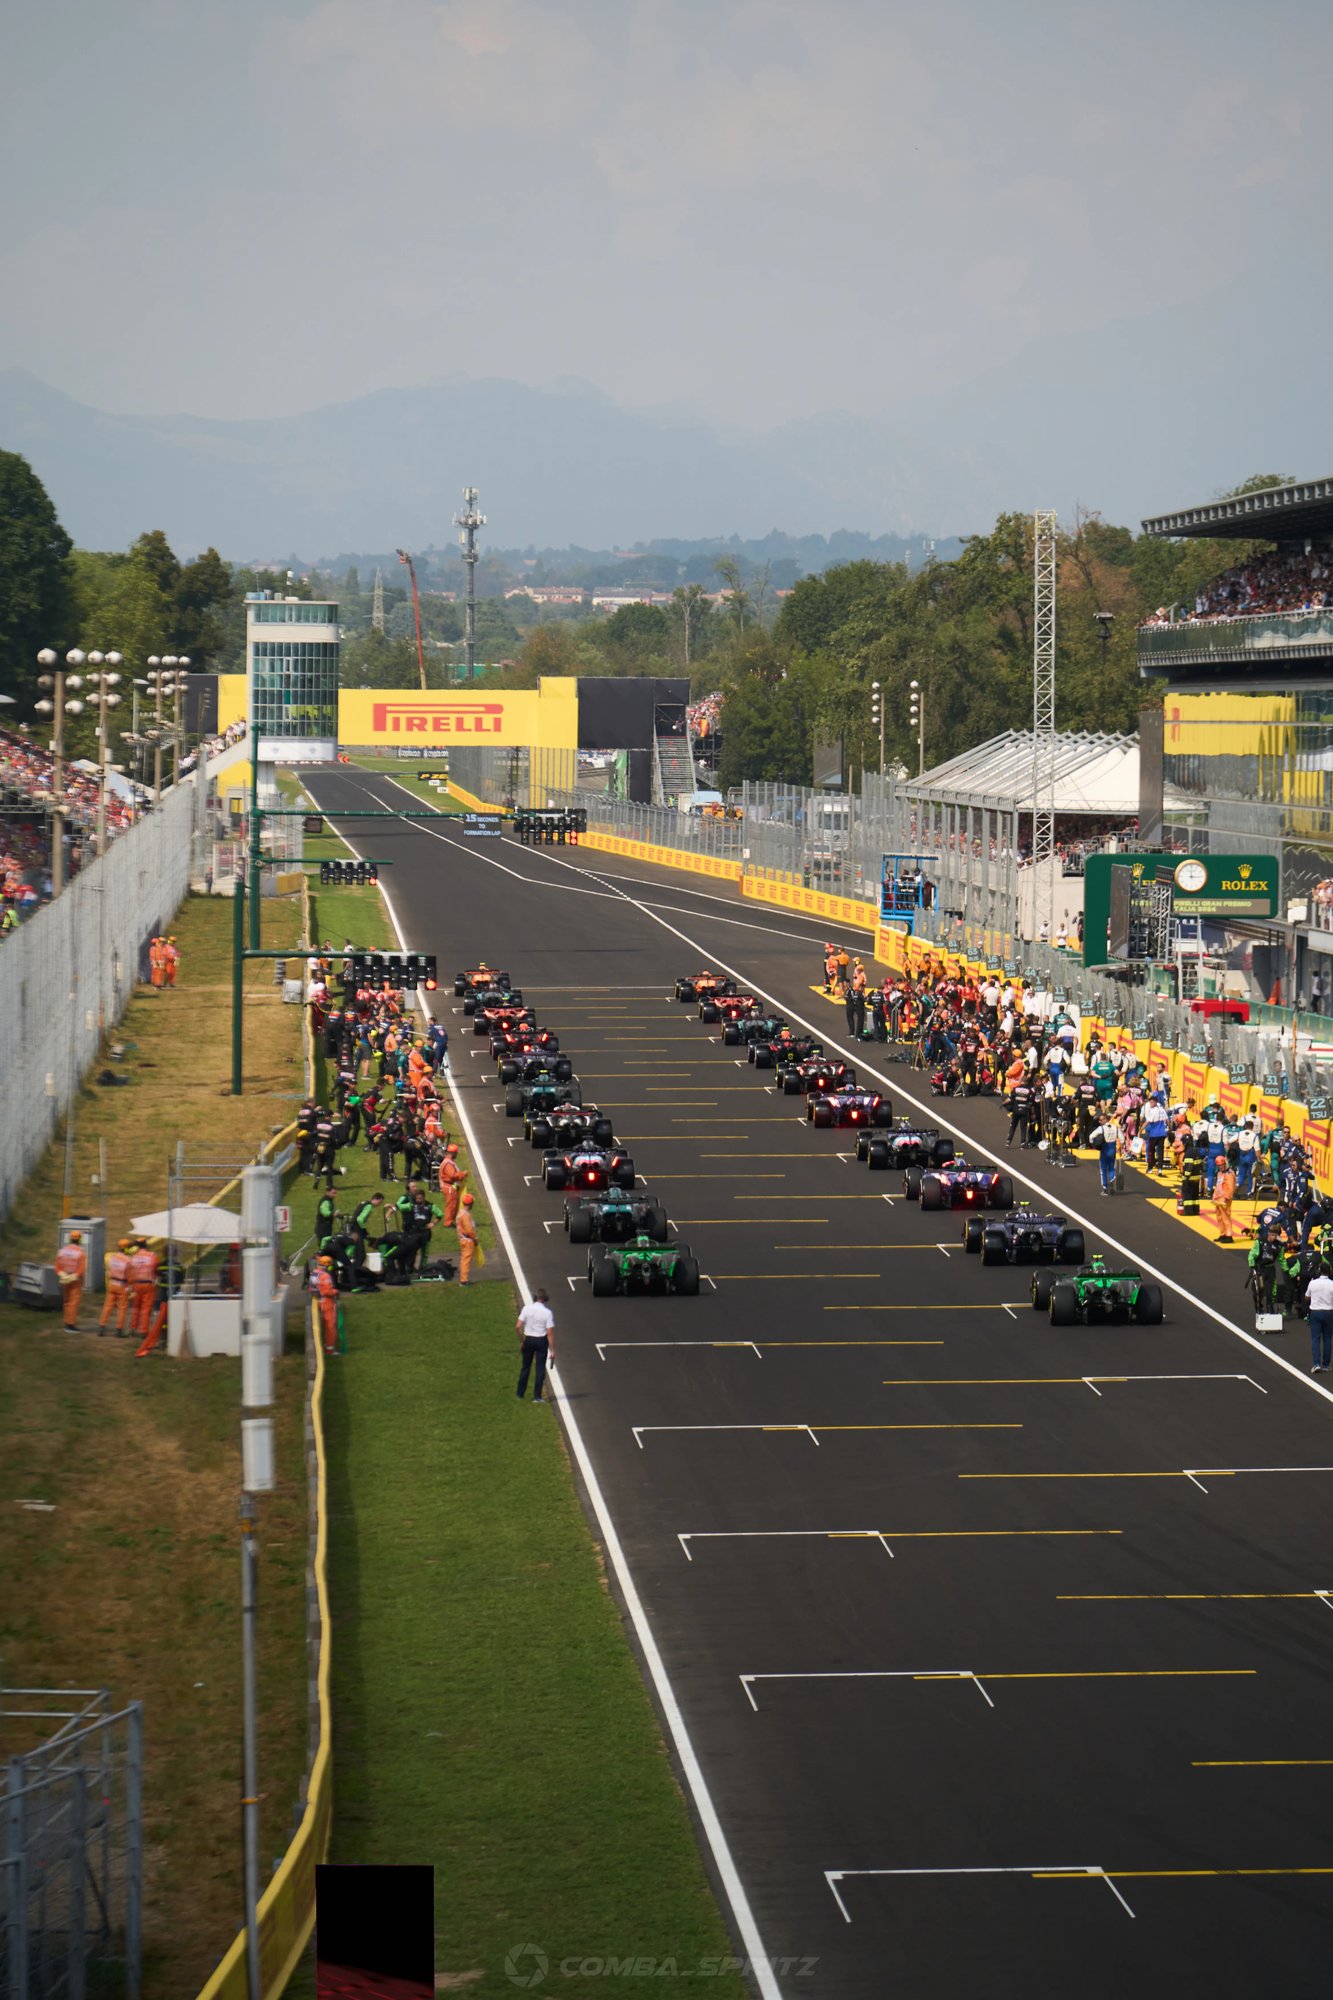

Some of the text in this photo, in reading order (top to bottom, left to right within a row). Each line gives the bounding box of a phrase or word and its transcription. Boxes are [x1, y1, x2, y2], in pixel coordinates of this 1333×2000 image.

[372, 703, 504, 732] PIRELLI
[465, 814, 477, 822] 15
[1221, 880, 1269, 891] ROLEX
[967, 947, 978, 955] 63
[1055, 986, 1065, 995] 11
[1081, 1000, 1093, 1009] 23
[1106, 1010, 1118, 1018] 27
[1134, 1022, 1146, 1031] 14
[1165, 1030, 1172, 1040] 3
[1192, 1044, 1206, 1053] 20
[1231, 1064, 1245, 1074] 10
[1231, 1075, 1247, 1083] GAS
[1266, 1075, 1278, 1085] 31
[1264, 1087, 1279, 1095] OCO
[1310, 1098, 1326, 1109] 22
[1311, 1111, 1327, 1119] TSU
